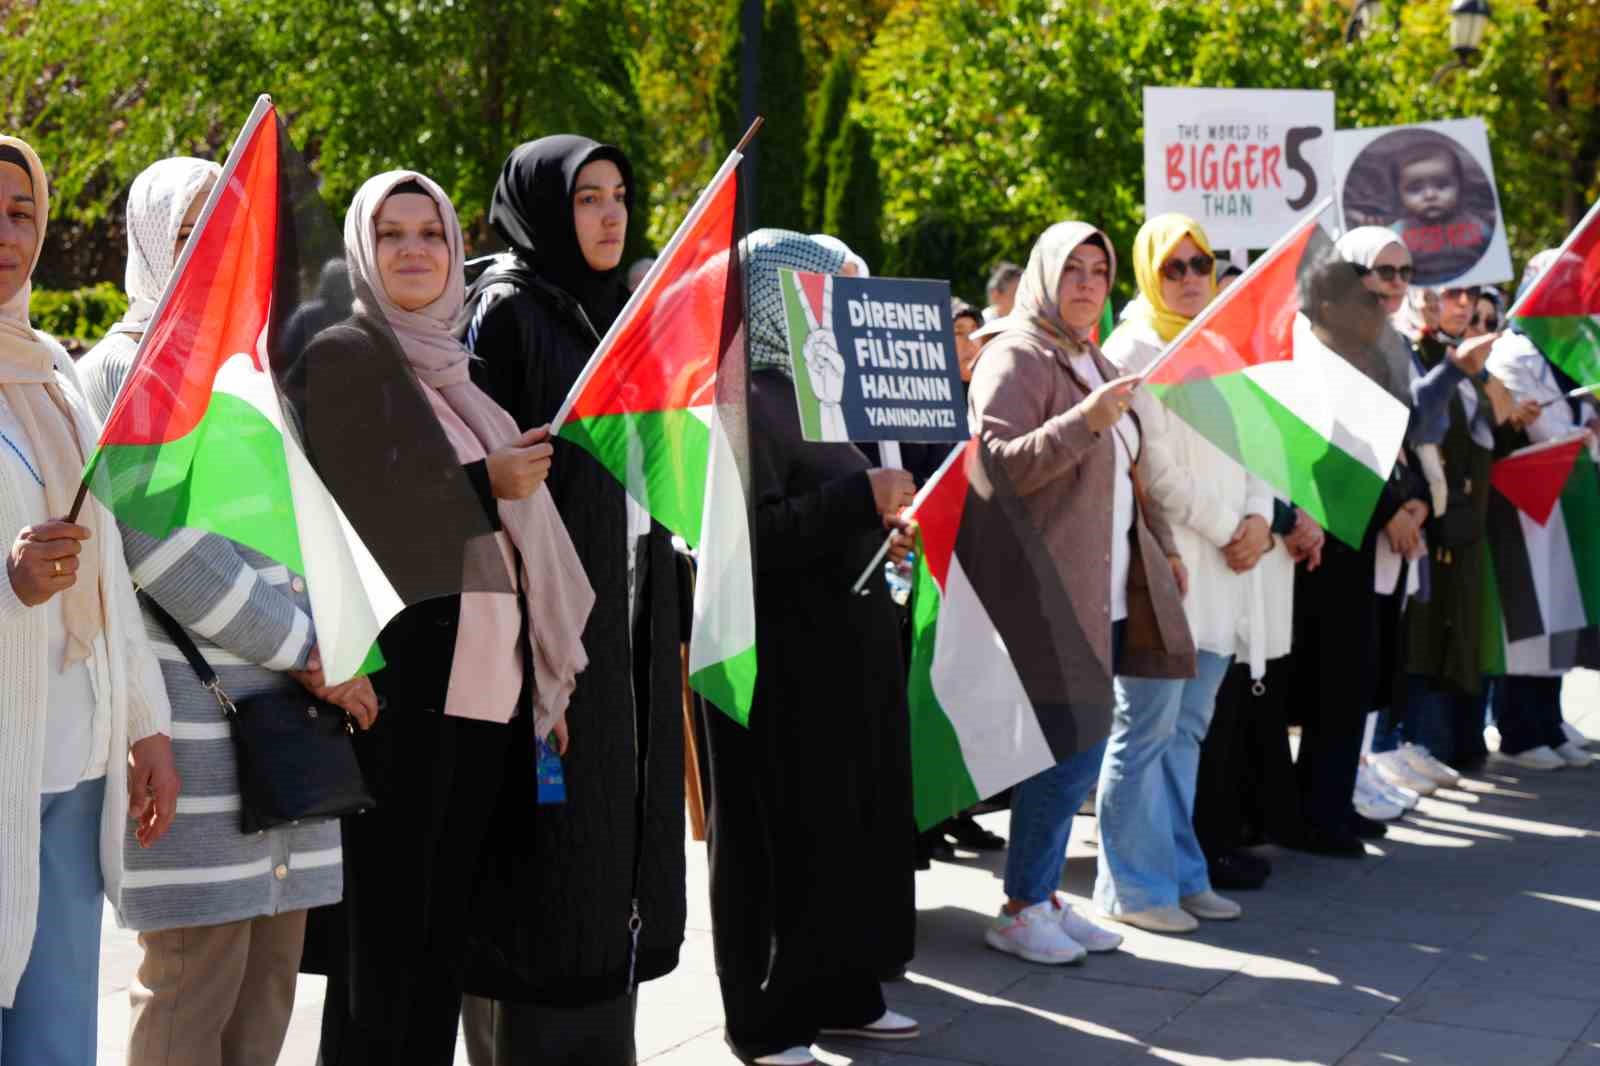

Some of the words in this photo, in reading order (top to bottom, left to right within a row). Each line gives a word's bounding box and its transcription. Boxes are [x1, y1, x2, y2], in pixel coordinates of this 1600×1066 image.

[1178, 124, 1200, 140] THE
[1208, 124, 1249, 141] WORLD
[1257, 124, 1269, 141] IS
[1165, 143, 1282, 193] BIGGER
[1285, 125, 1323, 211] 5
[1202, 193, 1252, 216] THAN
[847, 293, 942, 331] DİRENEN
[853, 331, 947, 370] FİLİSTİN
[859, 374, 952, 401] HALKININ
[864, 407, 957, 428] YANINDAYIZ!
